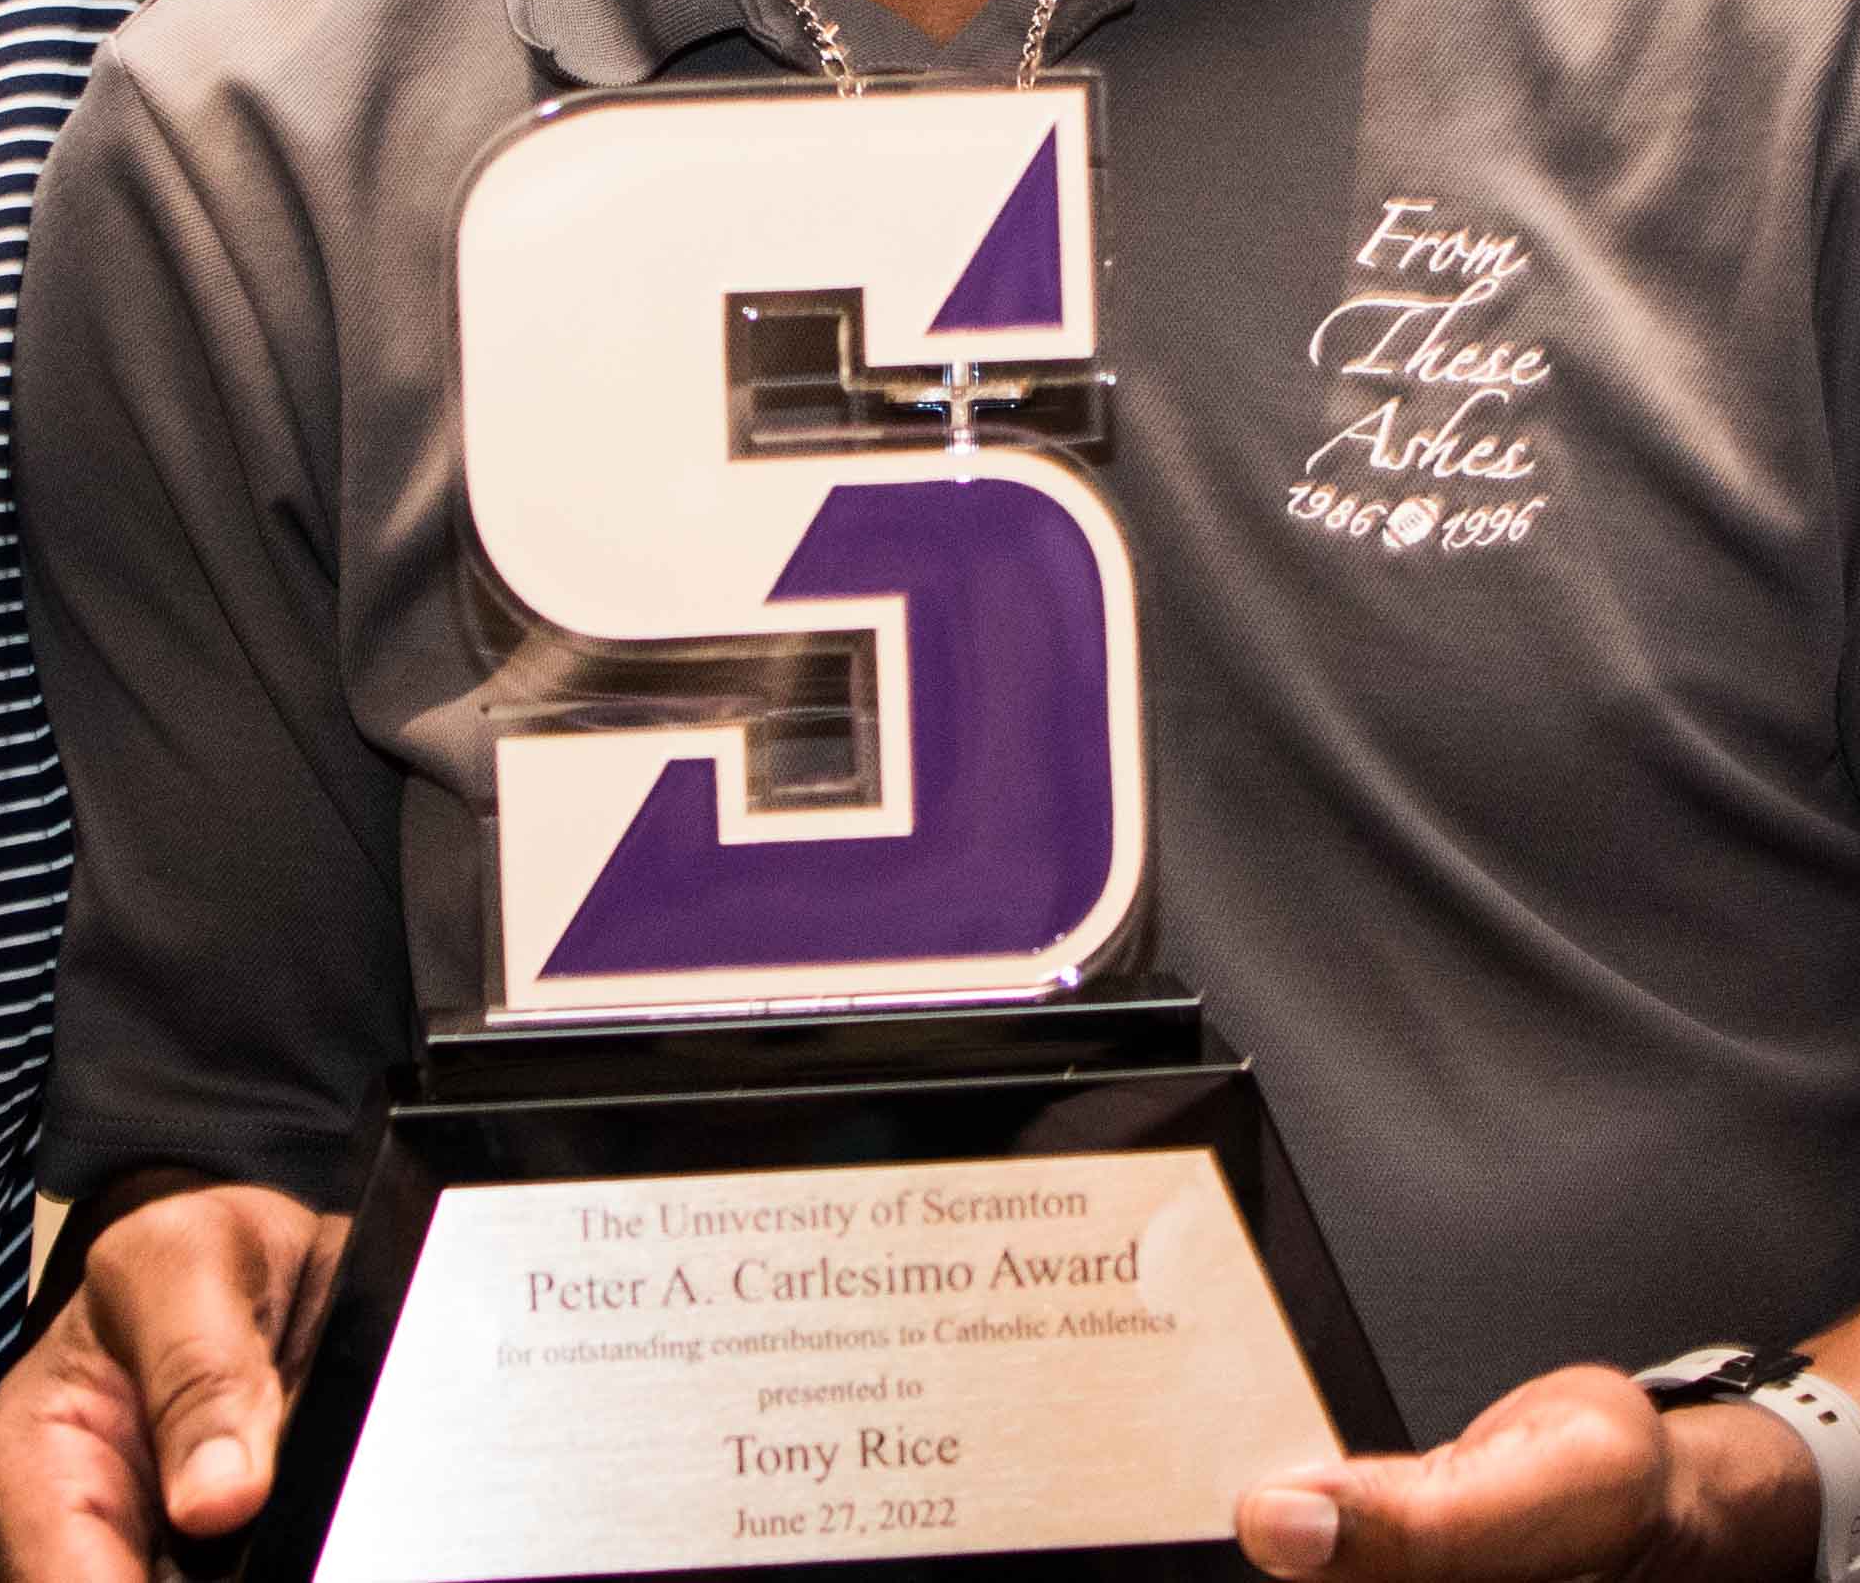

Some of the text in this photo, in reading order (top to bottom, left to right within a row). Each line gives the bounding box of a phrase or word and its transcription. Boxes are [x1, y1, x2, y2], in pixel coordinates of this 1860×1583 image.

[1355, 197, 1531, 276] From
[1309, 275, 1550, 385] These
[1305, 386, 1535, 480] Ashes
[1287, 482, 1548, 550] 1986 1996
[574, 1187, 1088, 1242] The University of Scranton
[527, 1240, 1139, 1313] Peter A. Carlesimo Award
[497, 1307, 1176, 1367] for outstanding contributions to Catholic Athletics
[757, 1375, 925, 1412] presented to
[723, 1425, 960, 1485] Tony Rice
[734, 1497, 957, 1539] June 27, 2022
